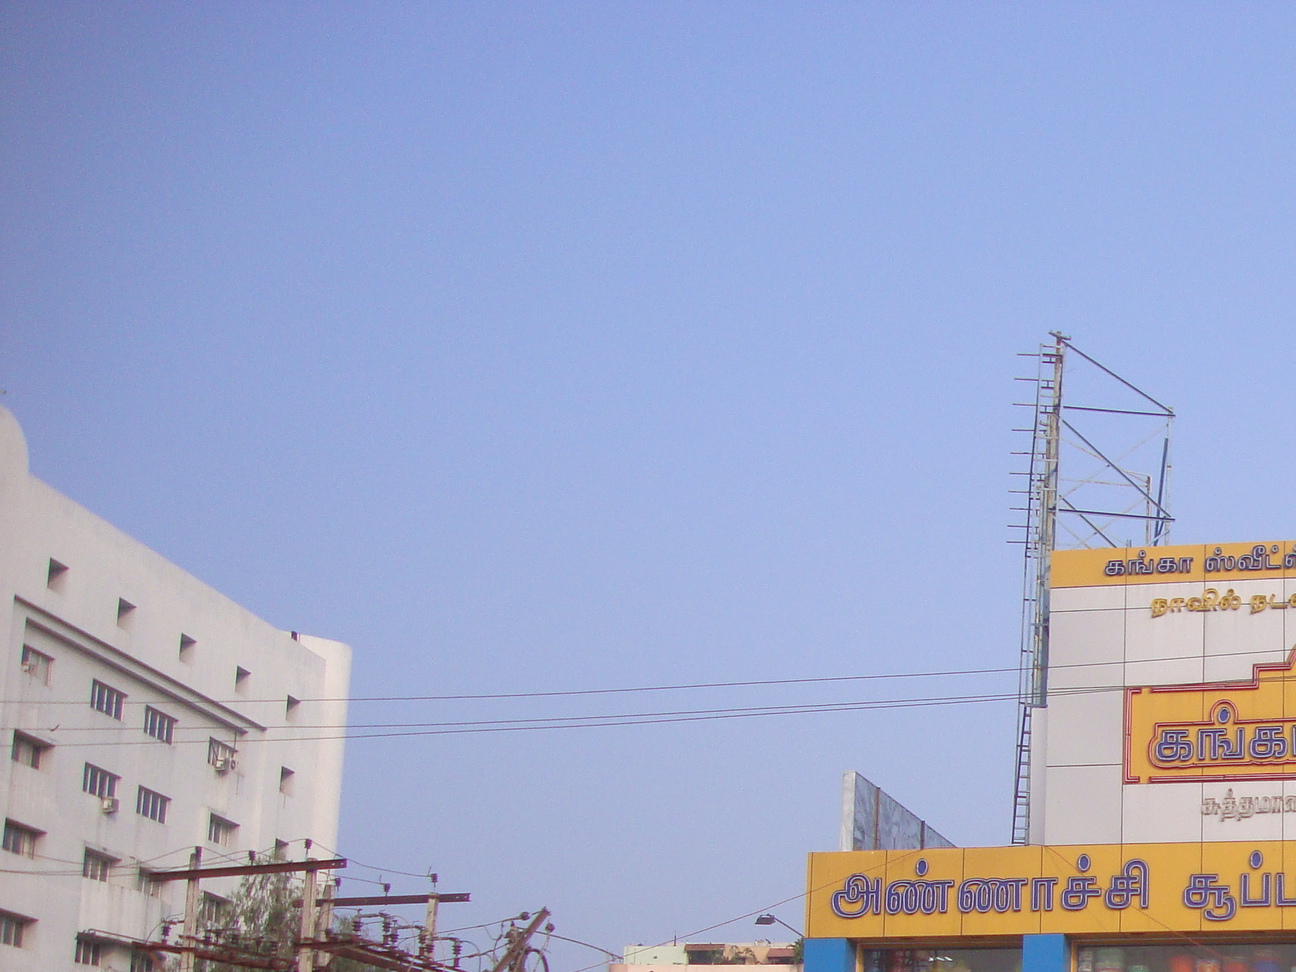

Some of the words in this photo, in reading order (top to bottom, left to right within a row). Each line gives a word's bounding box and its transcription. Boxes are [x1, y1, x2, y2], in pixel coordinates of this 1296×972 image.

[1103, 549, 1194, 577] கங்கா
[1150, 588, 1243, 618] நாவில்
[831, 853, 1151, 919] அண்ணாச்சி
